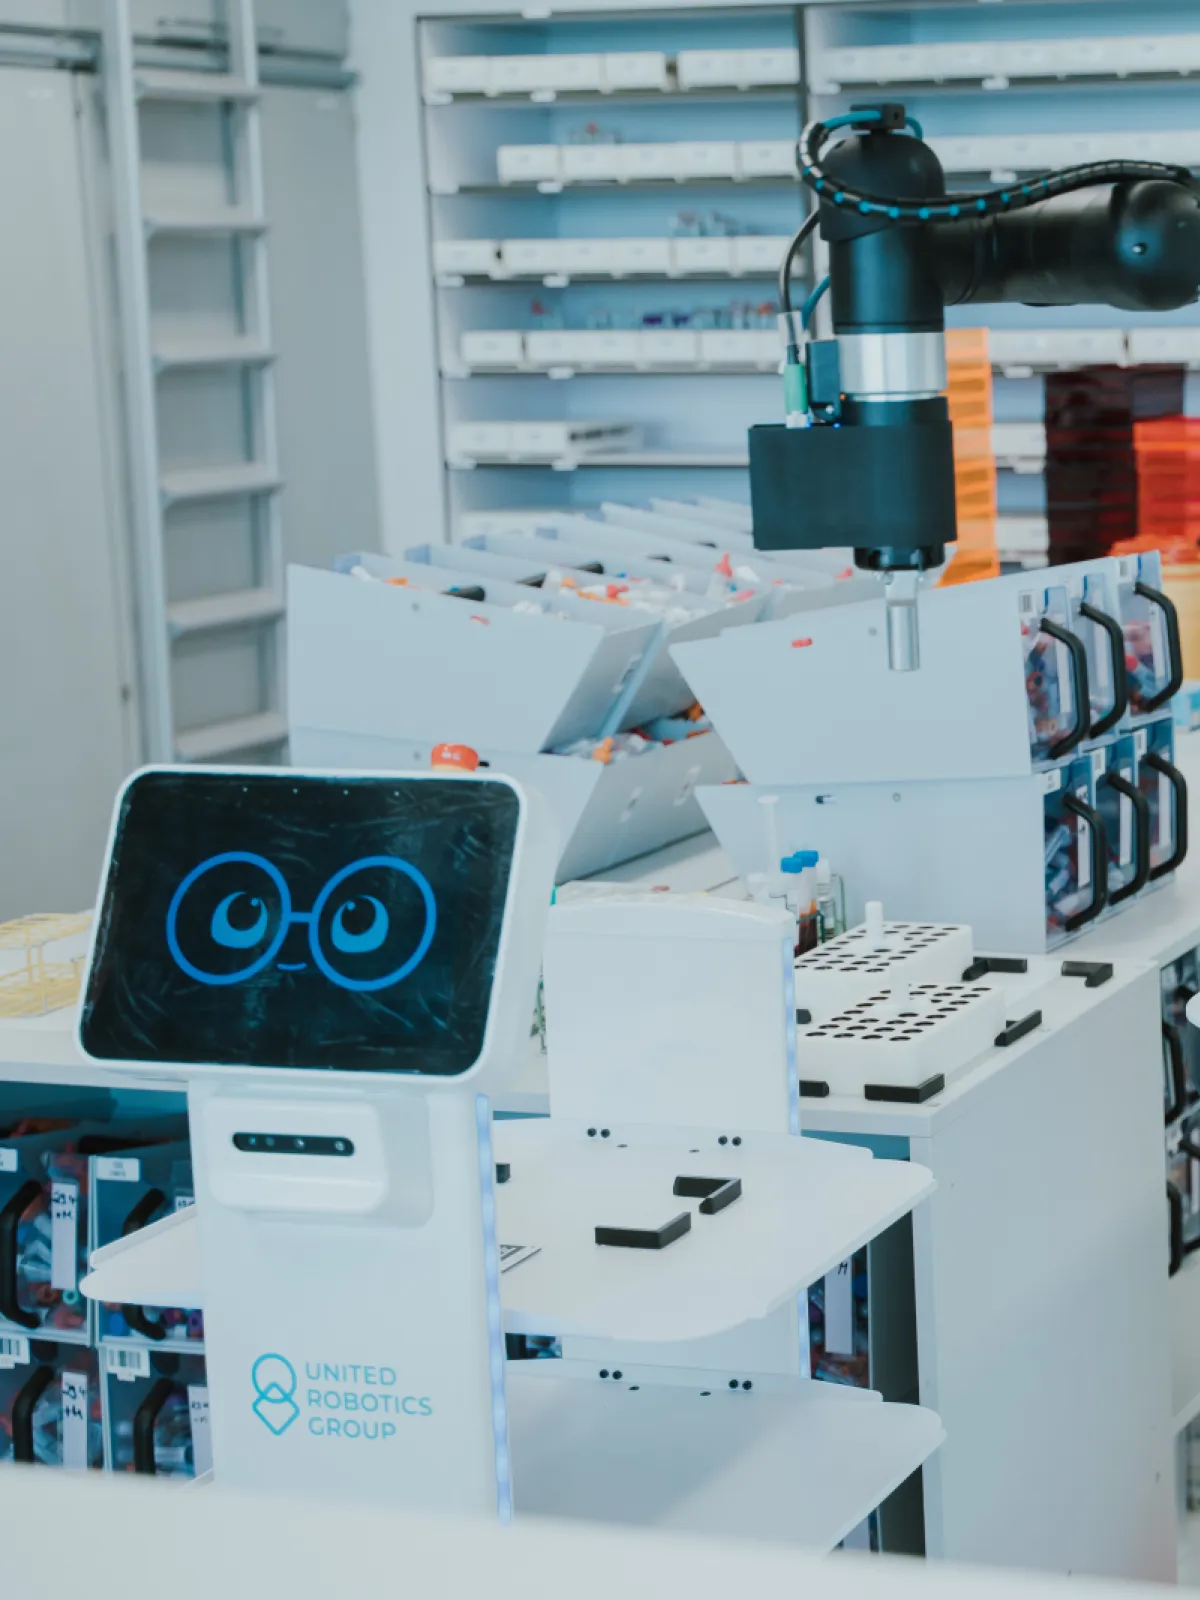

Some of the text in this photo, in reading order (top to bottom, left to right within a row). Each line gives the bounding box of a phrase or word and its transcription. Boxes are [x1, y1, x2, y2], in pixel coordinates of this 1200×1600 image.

[305, 1362, 397, 1386] UNITED
[307, 1389, 433, 1416] ROBOTICS
[308, 1416, 397, 1440] GROUP
